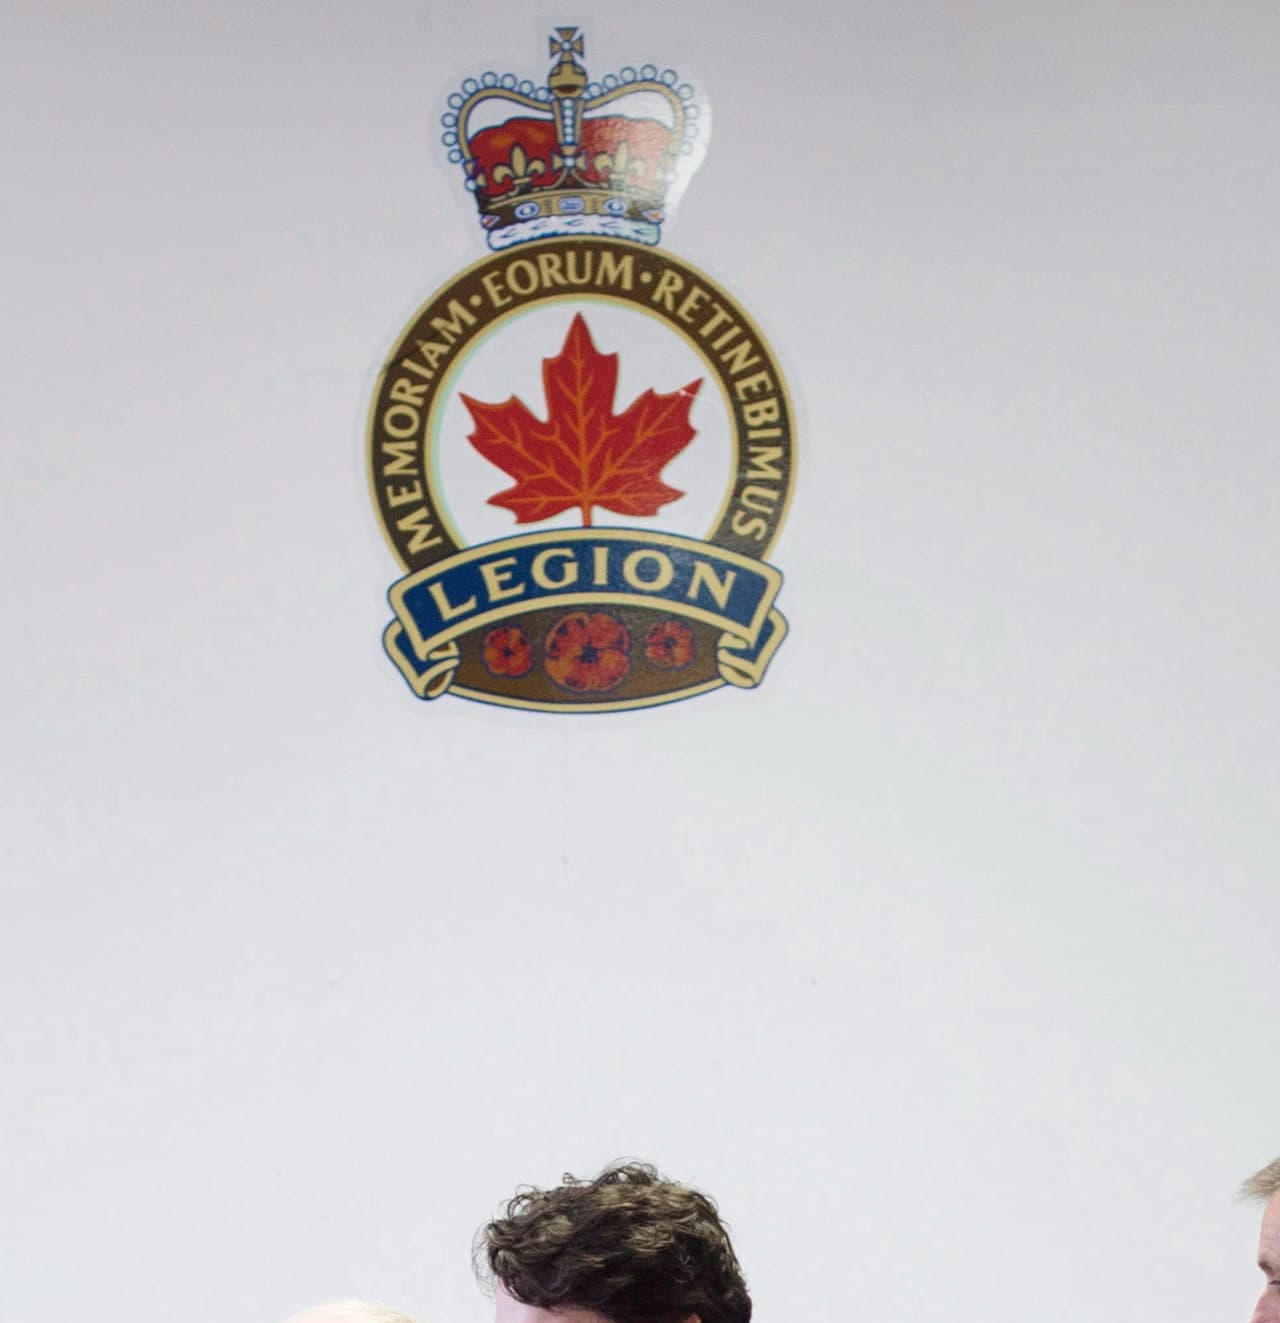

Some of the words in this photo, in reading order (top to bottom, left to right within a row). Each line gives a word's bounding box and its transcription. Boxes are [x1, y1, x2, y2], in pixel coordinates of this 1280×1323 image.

[381, 298, 477, 555] MEMORIAM
[481, 250, 634, 308] EORUM
[651, 268, 783, 541] RETINEBIMUS
[427, 547, 738, 622] LEGION
